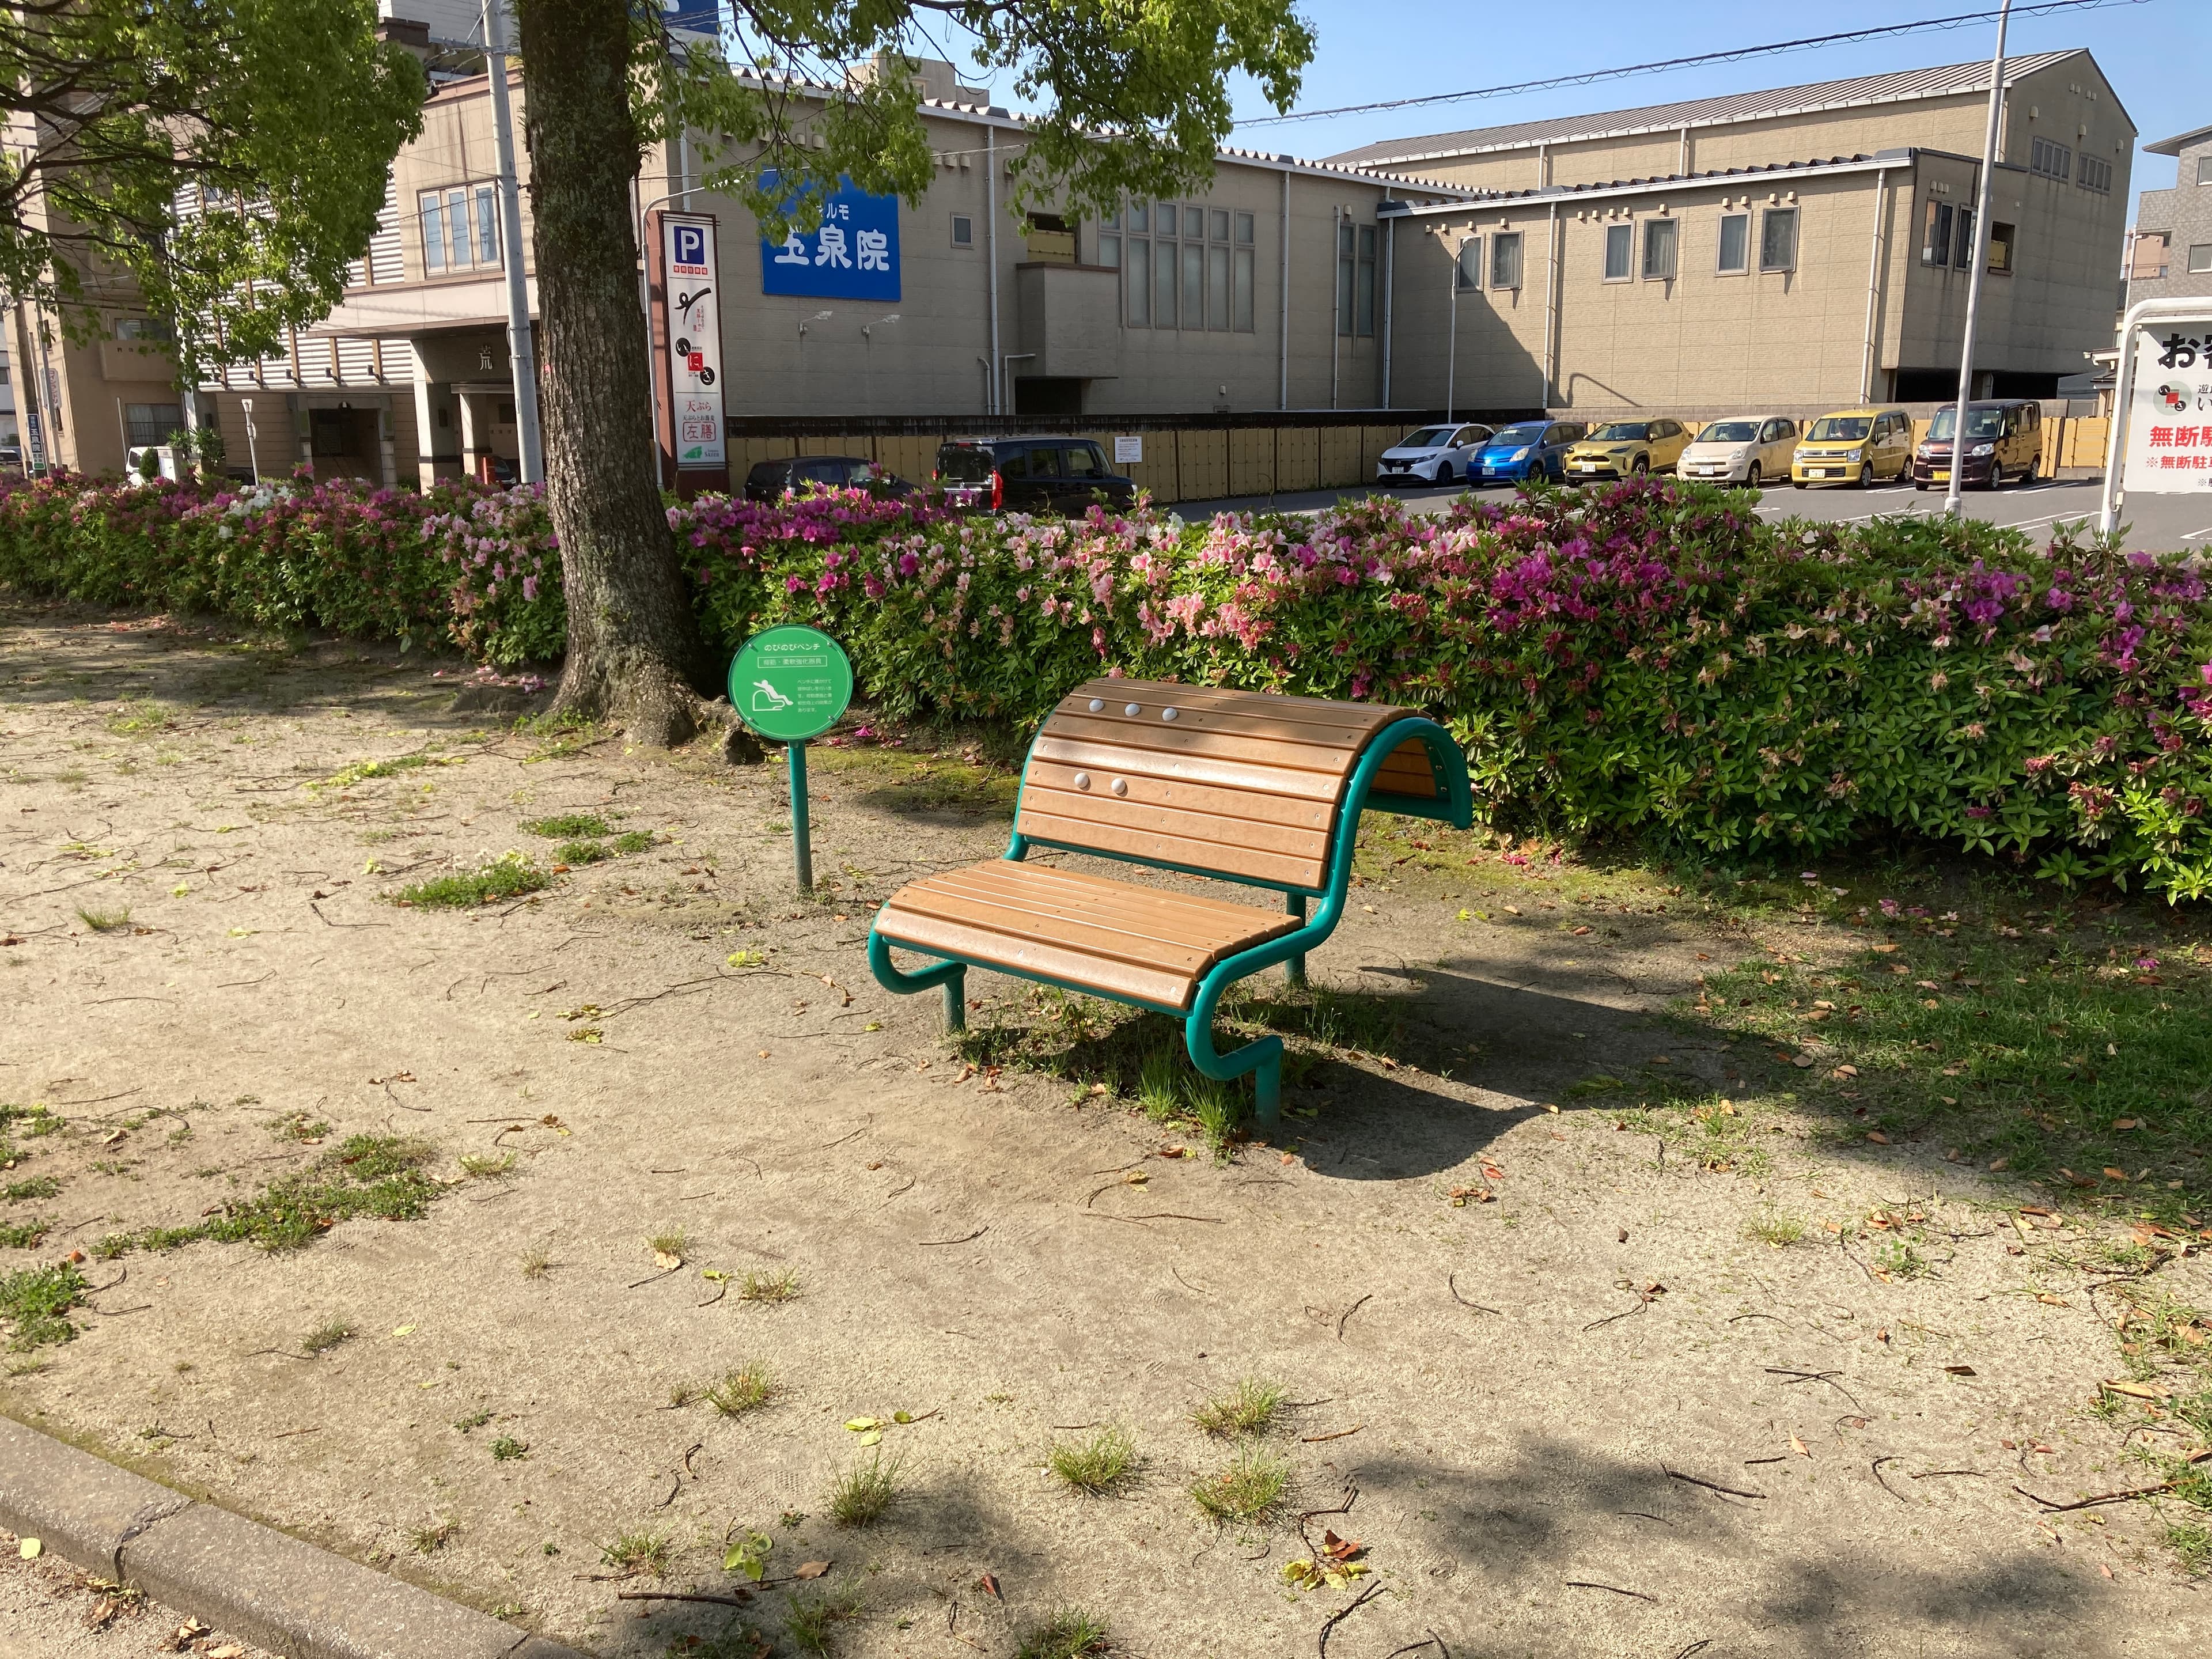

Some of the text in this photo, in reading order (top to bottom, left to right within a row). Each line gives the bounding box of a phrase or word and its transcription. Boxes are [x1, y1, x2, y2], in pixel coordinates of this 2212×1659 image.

[680, 230, 700, 261] P
[774, 222, 890, 271] 玉泉院
[2157, 333, 2212, 369] お
[2198, 384, 2212, 394] 遊
[686, 400, 712, 412] 天ぷら
[687, 423, 713, 439] 左膳
[764, 643, 821, 651] のびのびベンチ
